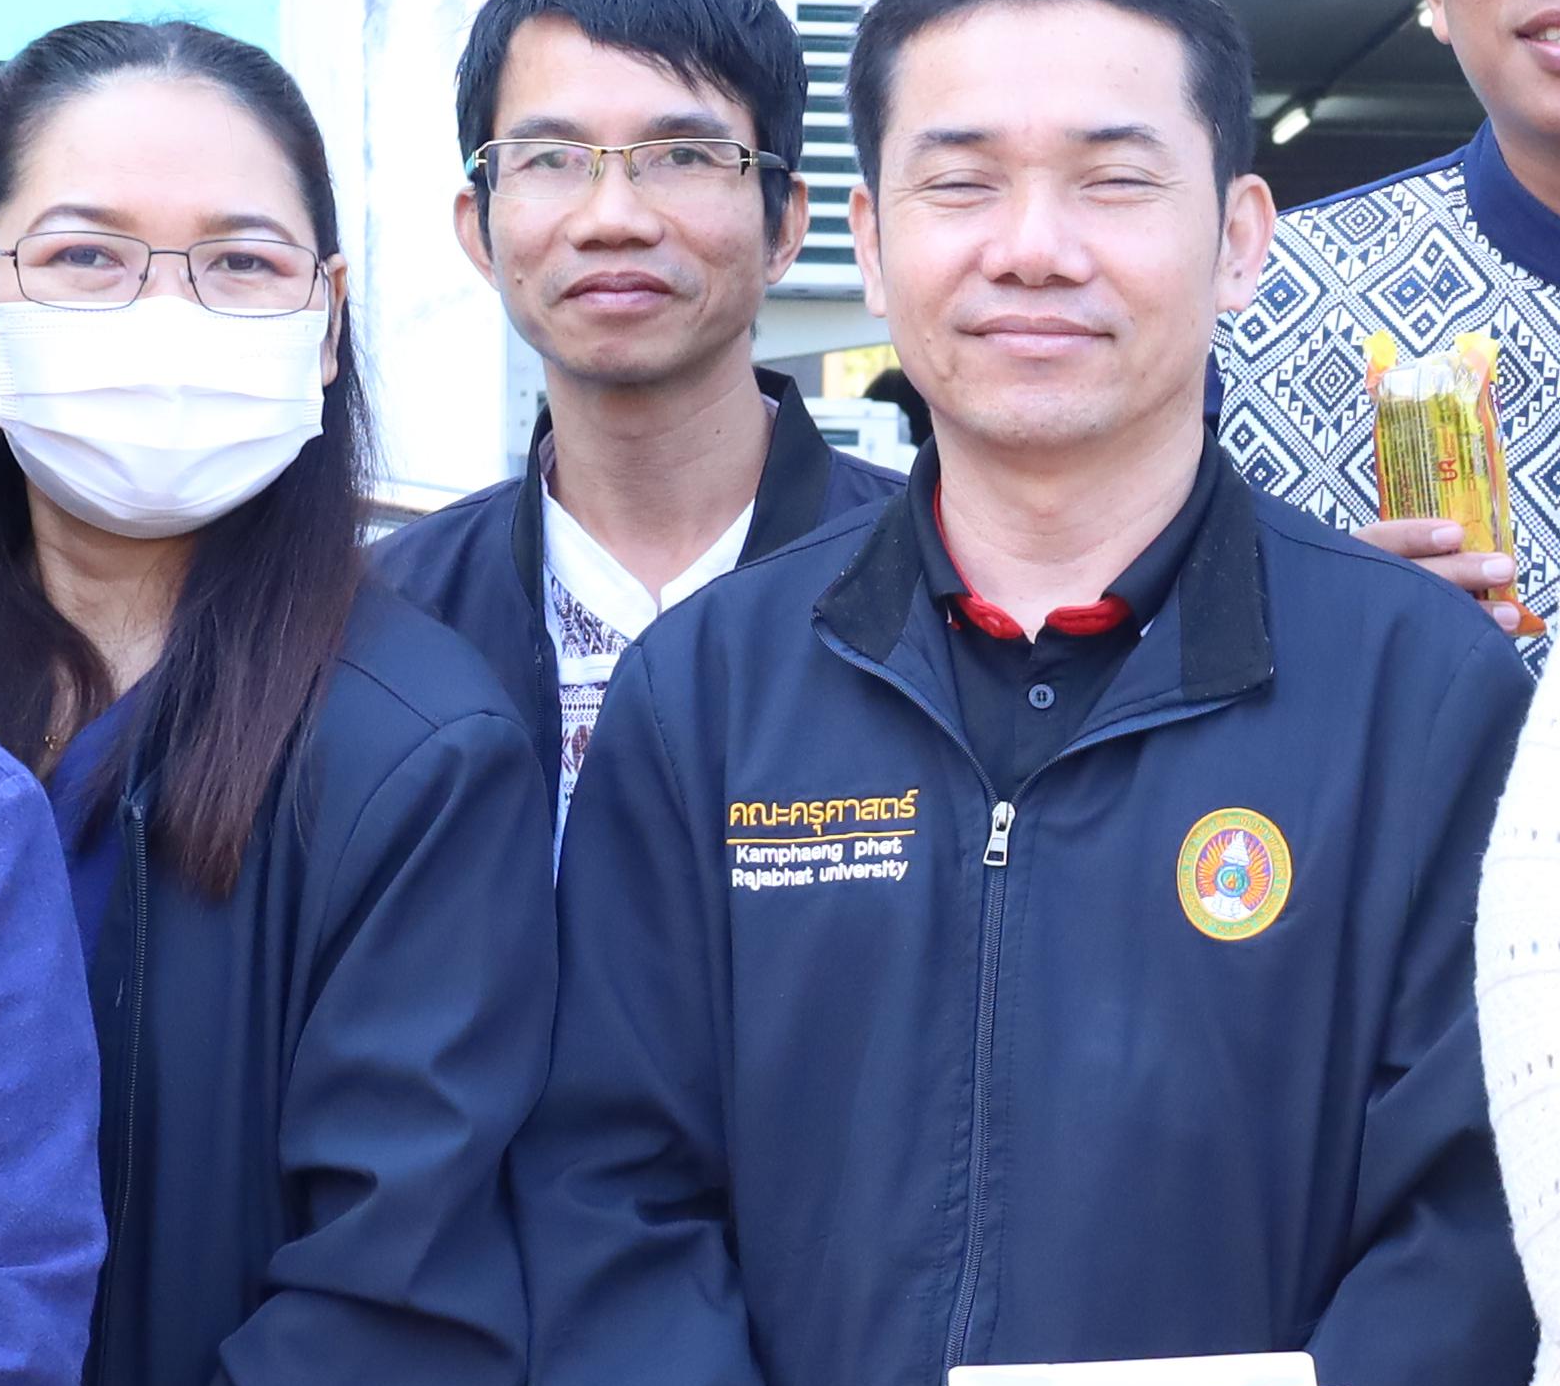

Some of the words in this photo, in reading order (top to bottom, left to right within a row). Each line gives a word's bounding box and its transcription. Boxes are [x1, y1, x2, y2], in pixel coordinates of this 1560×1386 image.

[729, 788, 920, 836] คณะครุศาสตร์
[736, 841, 844, 867] Kamphaeng
[854, 836, 903, 860] phet
[731, 865, 815, 892] Rajabhat
[819, 858, 909, 882] university
